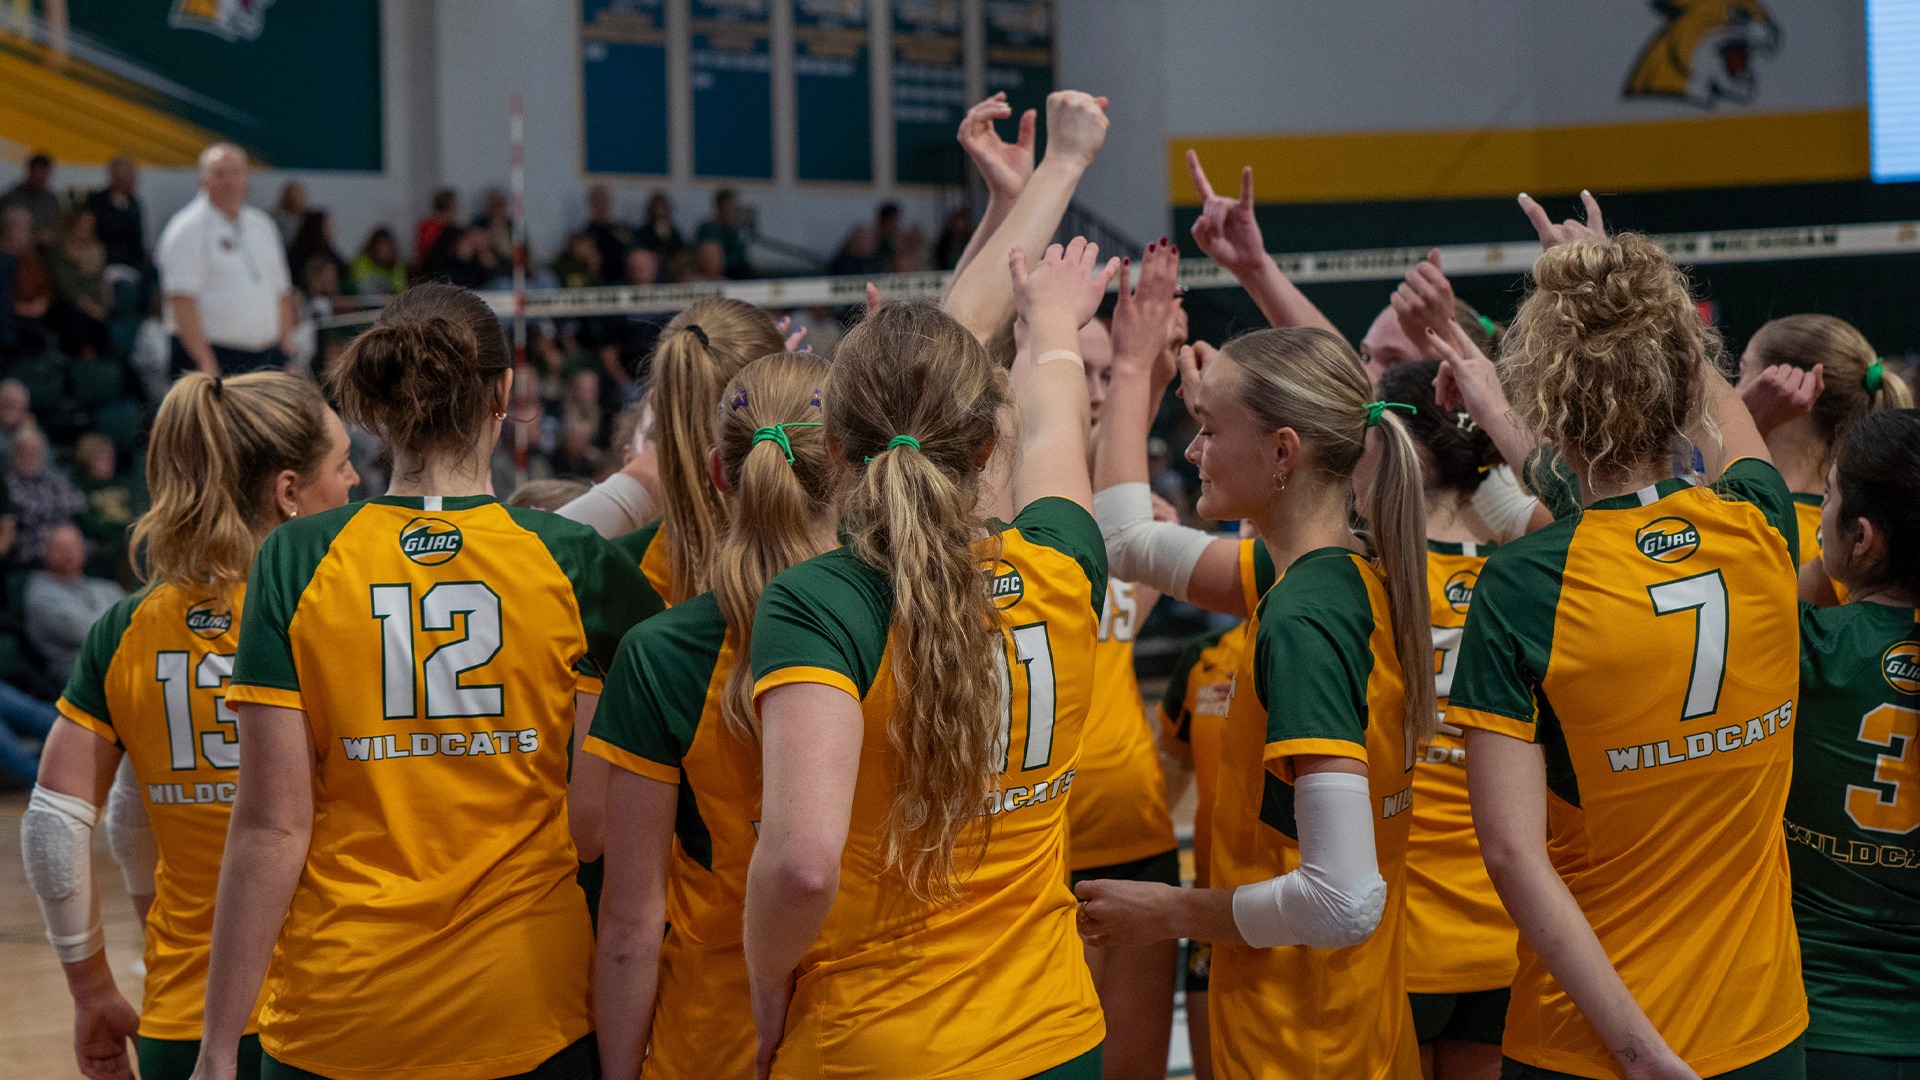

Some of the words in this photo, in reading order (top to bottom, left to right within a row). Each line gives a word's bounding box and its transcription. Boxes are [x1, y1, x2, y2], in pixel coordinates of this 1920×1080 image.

[404, 535, 460, 552] GLIAC
[1643, 531, 1696, 554] GLIAC
[370, 580, 504, 720] 12
[1646, 568, 1729, 722] 7
[156, 650, 240, 771] 13
[340, 727, 540, 762] WILDCATS
[1605, 700, 1793, 772] WILDCATS
[978, 767, 1077, 816] DCATS
[1844, 702, 1920, 835] 3
